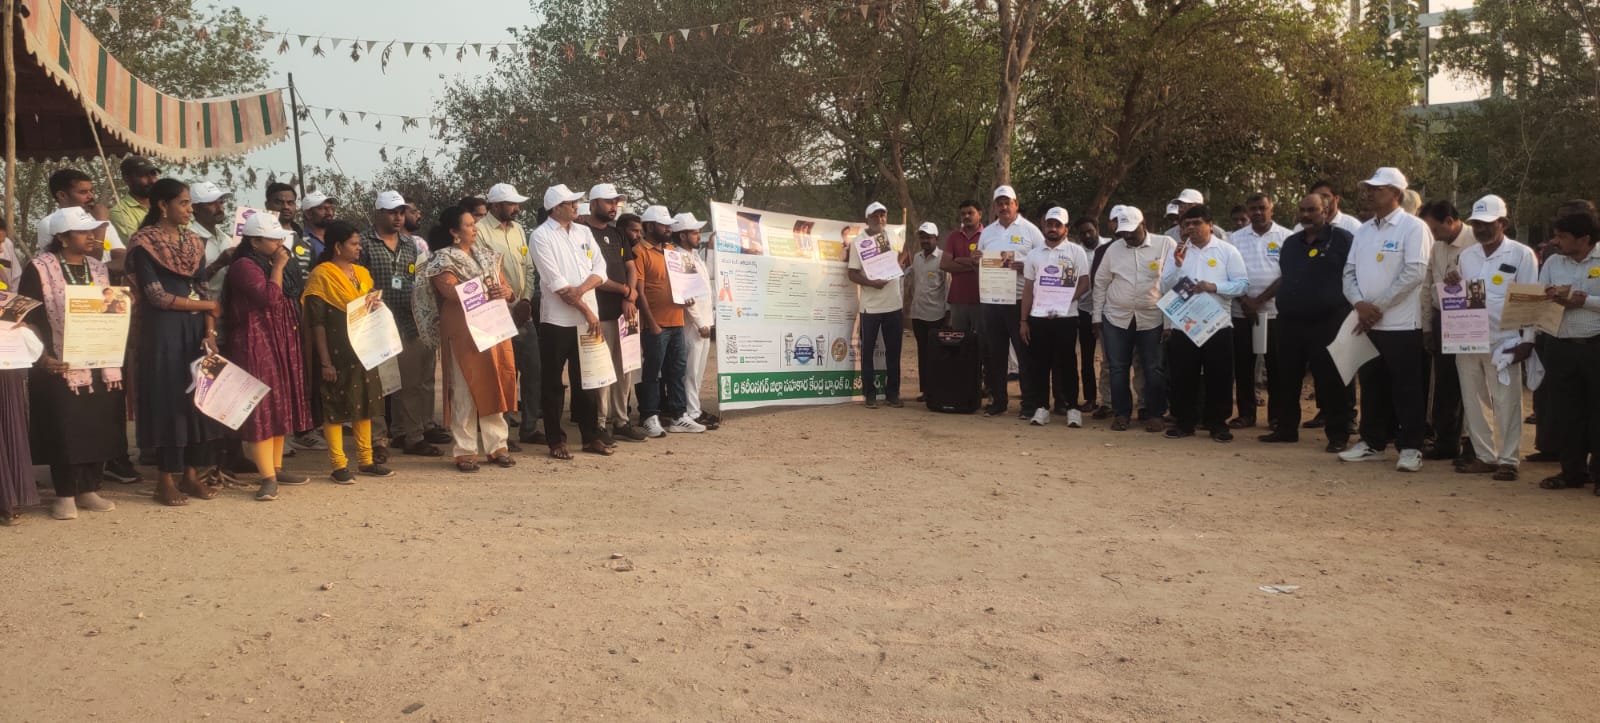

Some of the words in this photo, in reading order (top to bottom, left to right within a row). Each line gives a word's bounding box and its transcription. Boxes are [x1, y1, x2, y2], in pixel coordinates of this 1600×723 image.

[733, 382, 740, 394] ది
[740, 377, 769, 394] కరీంనగర్
[770, 380, 783, 397] జిల్లా
[783, 378, 808, 393] సహకార
[808, 375, 823, 395] కేంద్ర
[824, 375, 844, 396] బ్యాంక్
